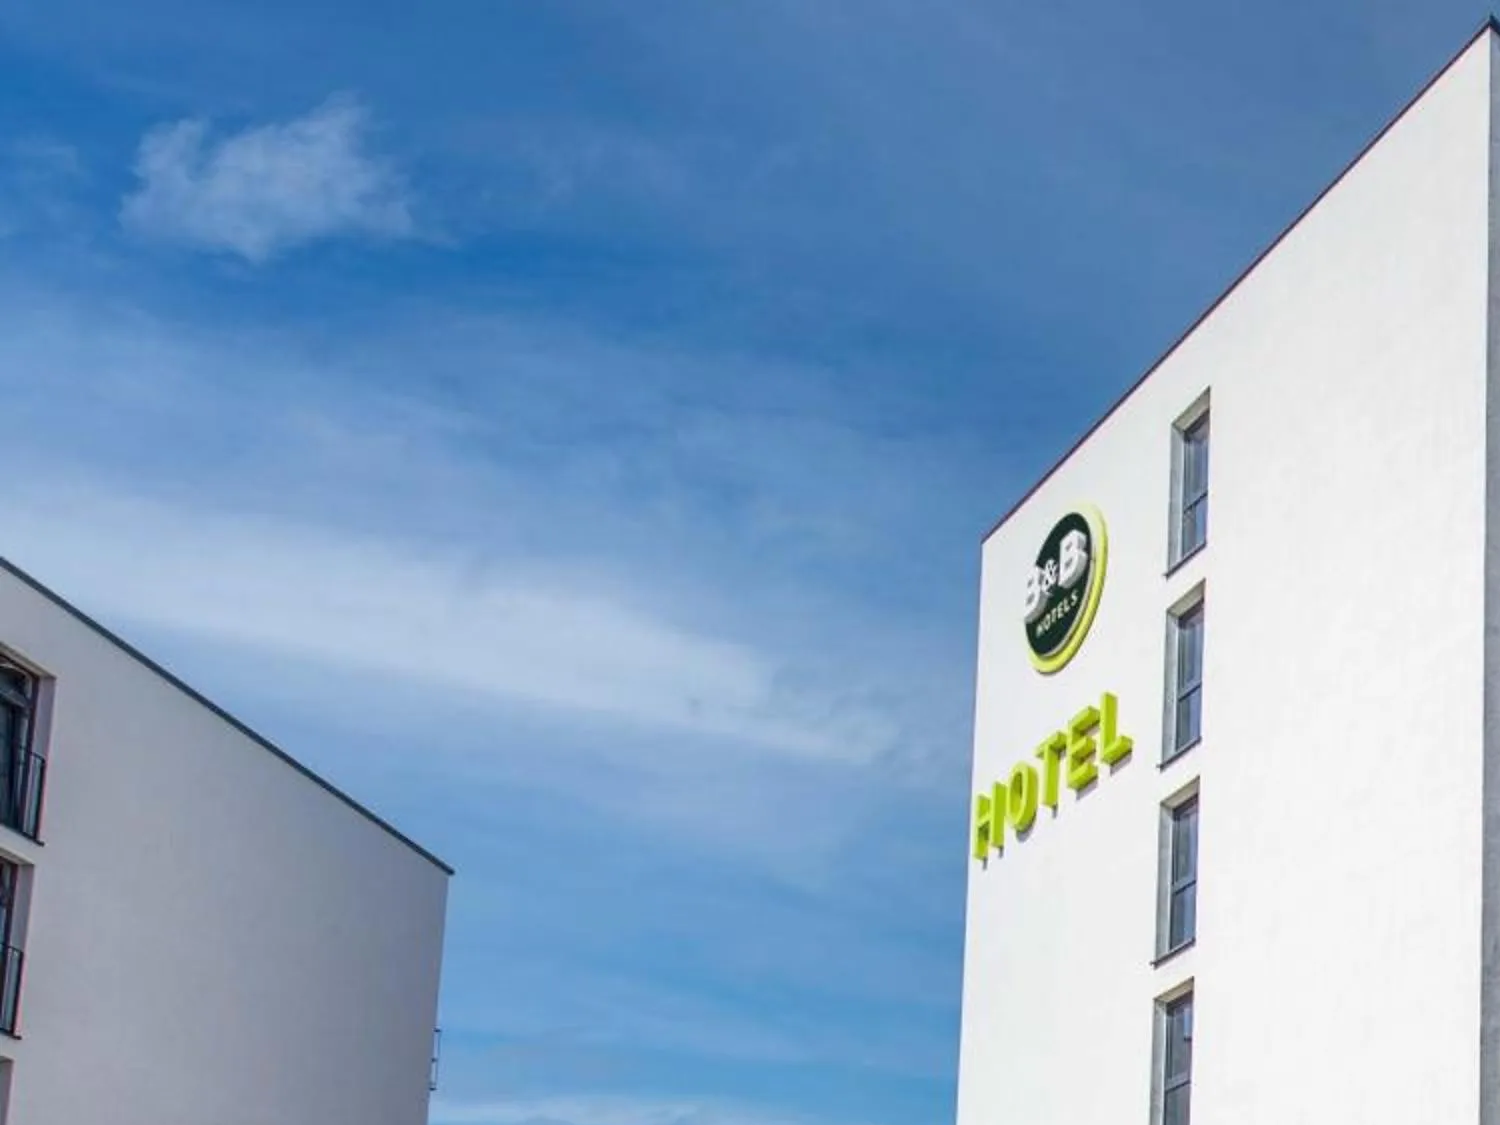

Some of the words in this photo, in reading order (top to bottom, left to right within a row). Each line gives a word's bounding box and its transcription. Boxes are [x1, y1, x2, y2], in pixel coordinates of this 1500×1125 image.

[1024, 529, 1088, 624] B&B
[1036, 590, 1079, 638] HOTELS
[974, 692, 1134, 861] HOTEL
